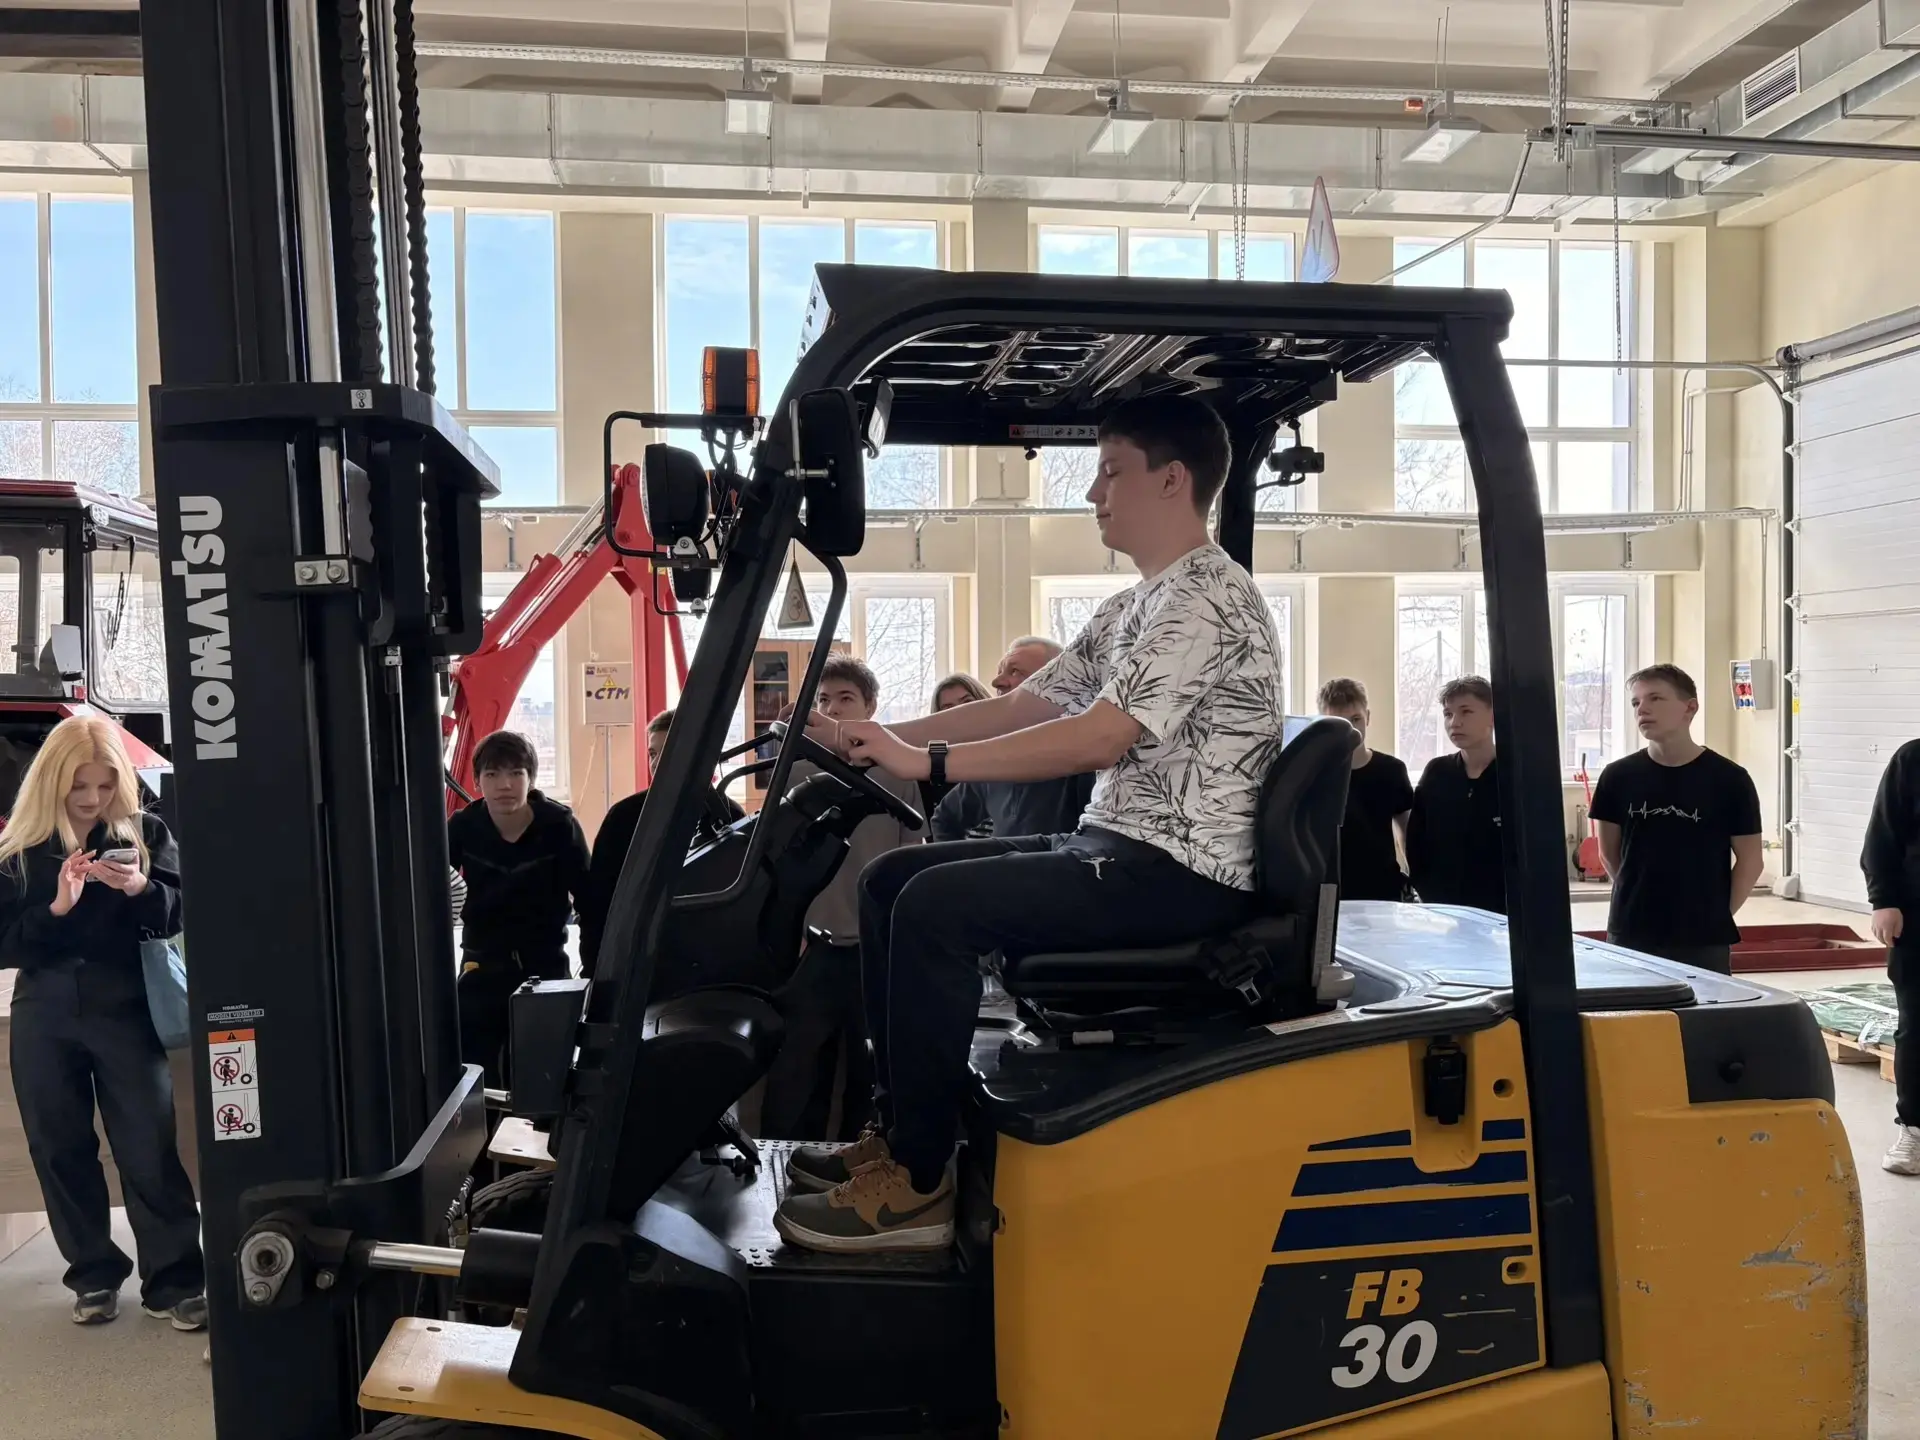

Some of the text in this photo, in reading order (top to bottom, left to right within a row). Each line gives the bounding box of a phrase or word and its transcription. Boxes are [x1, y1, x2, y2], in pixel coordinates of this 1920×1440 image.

[171, 495, 238, 761] KOMATSU
[1345, 1268, 1424, 1320] FB
[1331, 1320, 1438, 1388] 30
